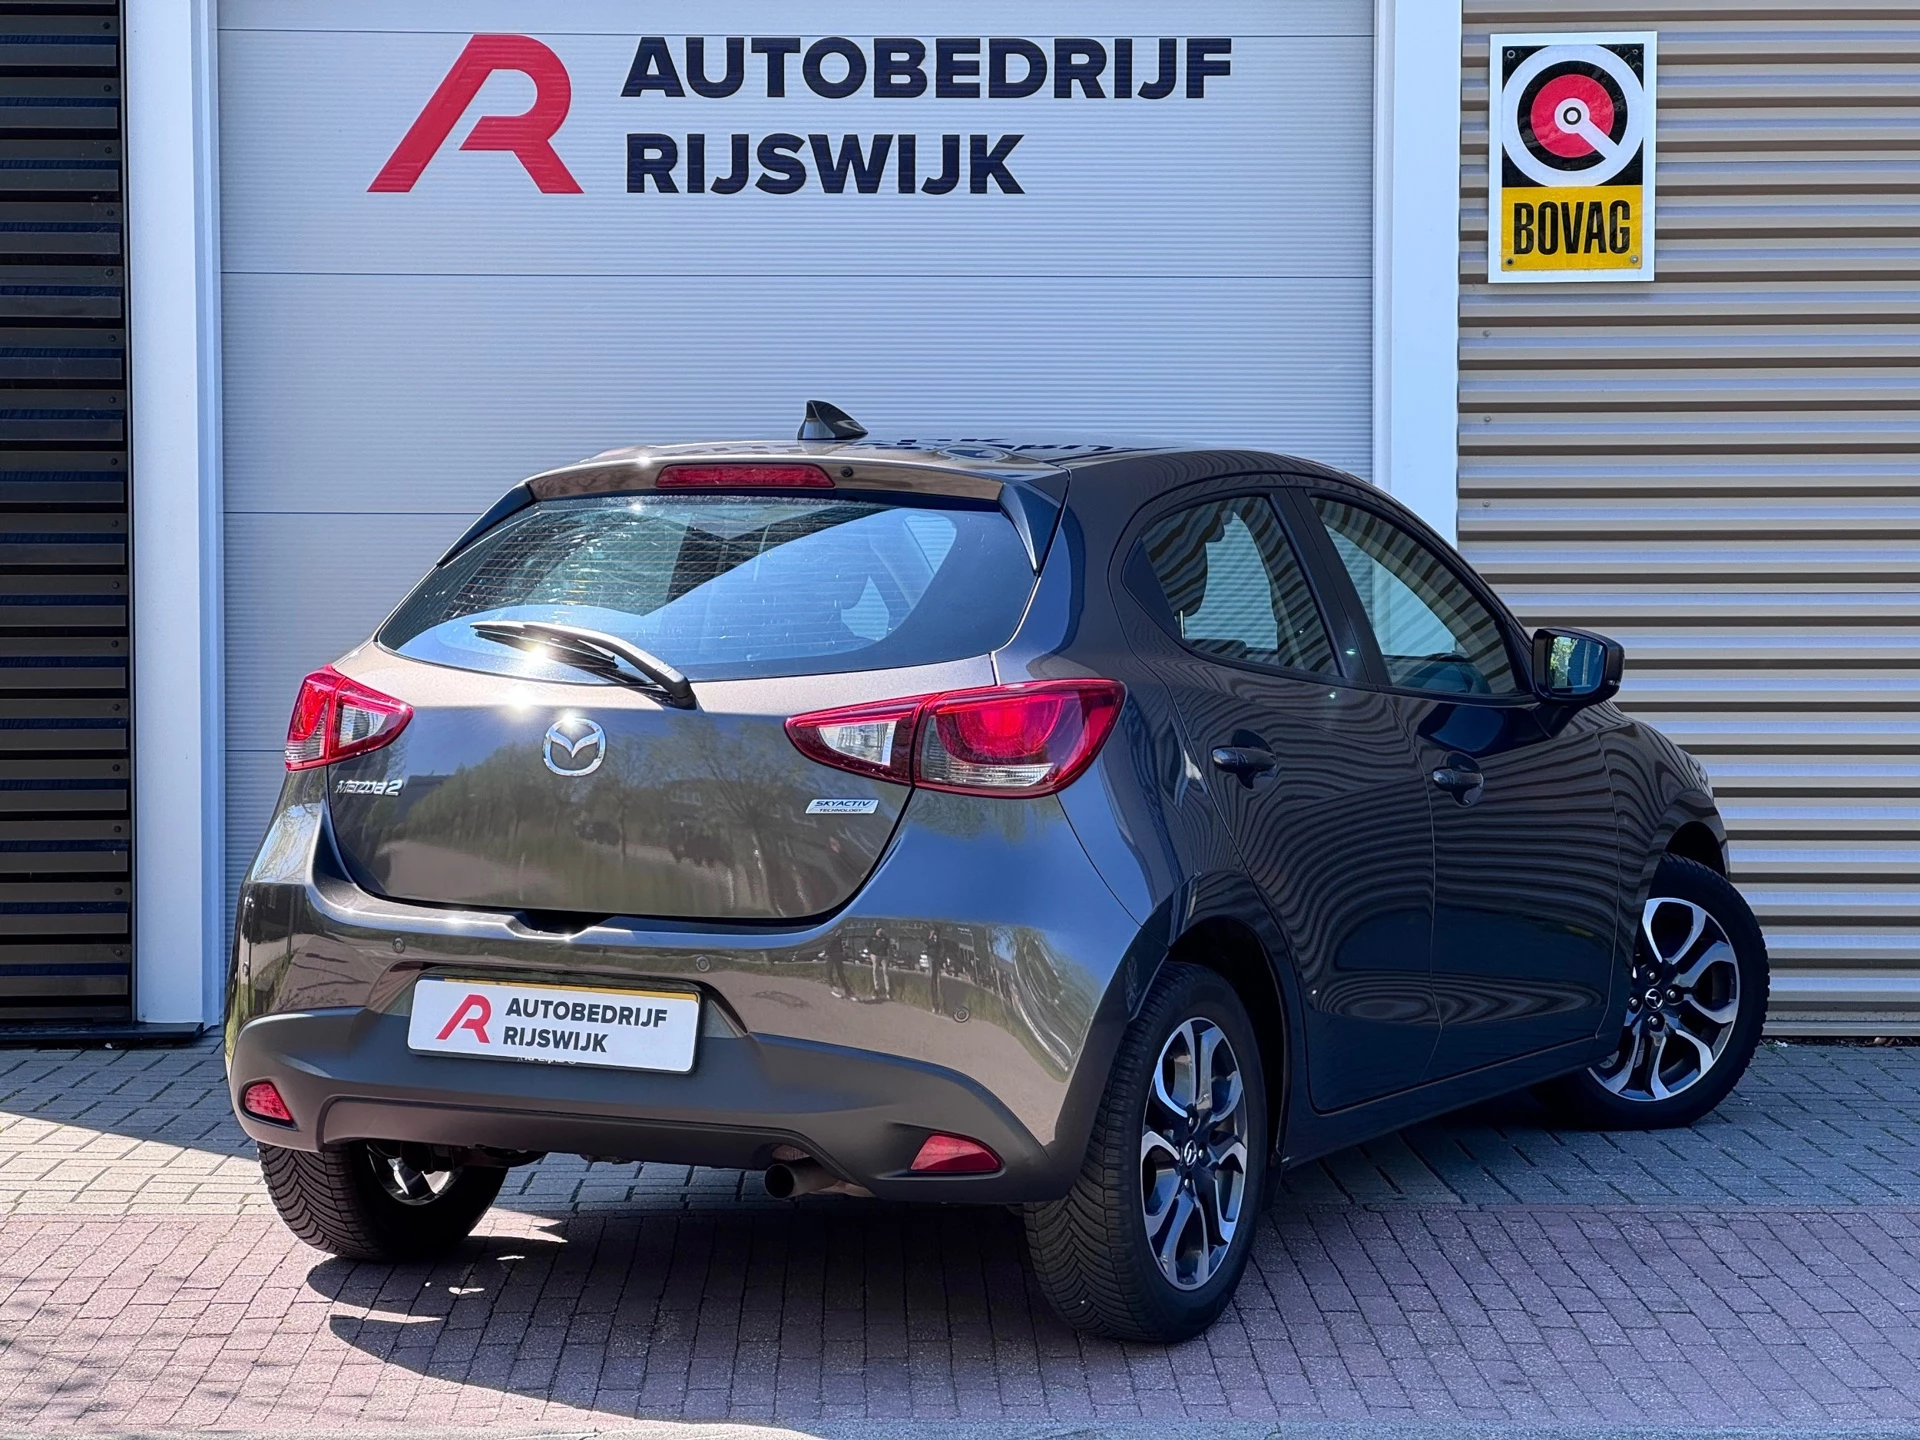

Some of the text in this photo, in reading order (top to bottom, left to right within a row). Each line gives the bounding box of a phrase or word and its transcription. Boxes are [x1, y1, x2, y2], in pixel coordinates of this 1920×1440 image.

[621, 36, 1232, 100] AUTOBEDRIJF
[626, 133, 1025, 195] RIJSWIJK
[1513, 199, 1630, 256] BOVAG
[502, 1026, 608, 1053] RIJSWIJK
[505, 997, 668, 1028] AUTOBEDRIJF
